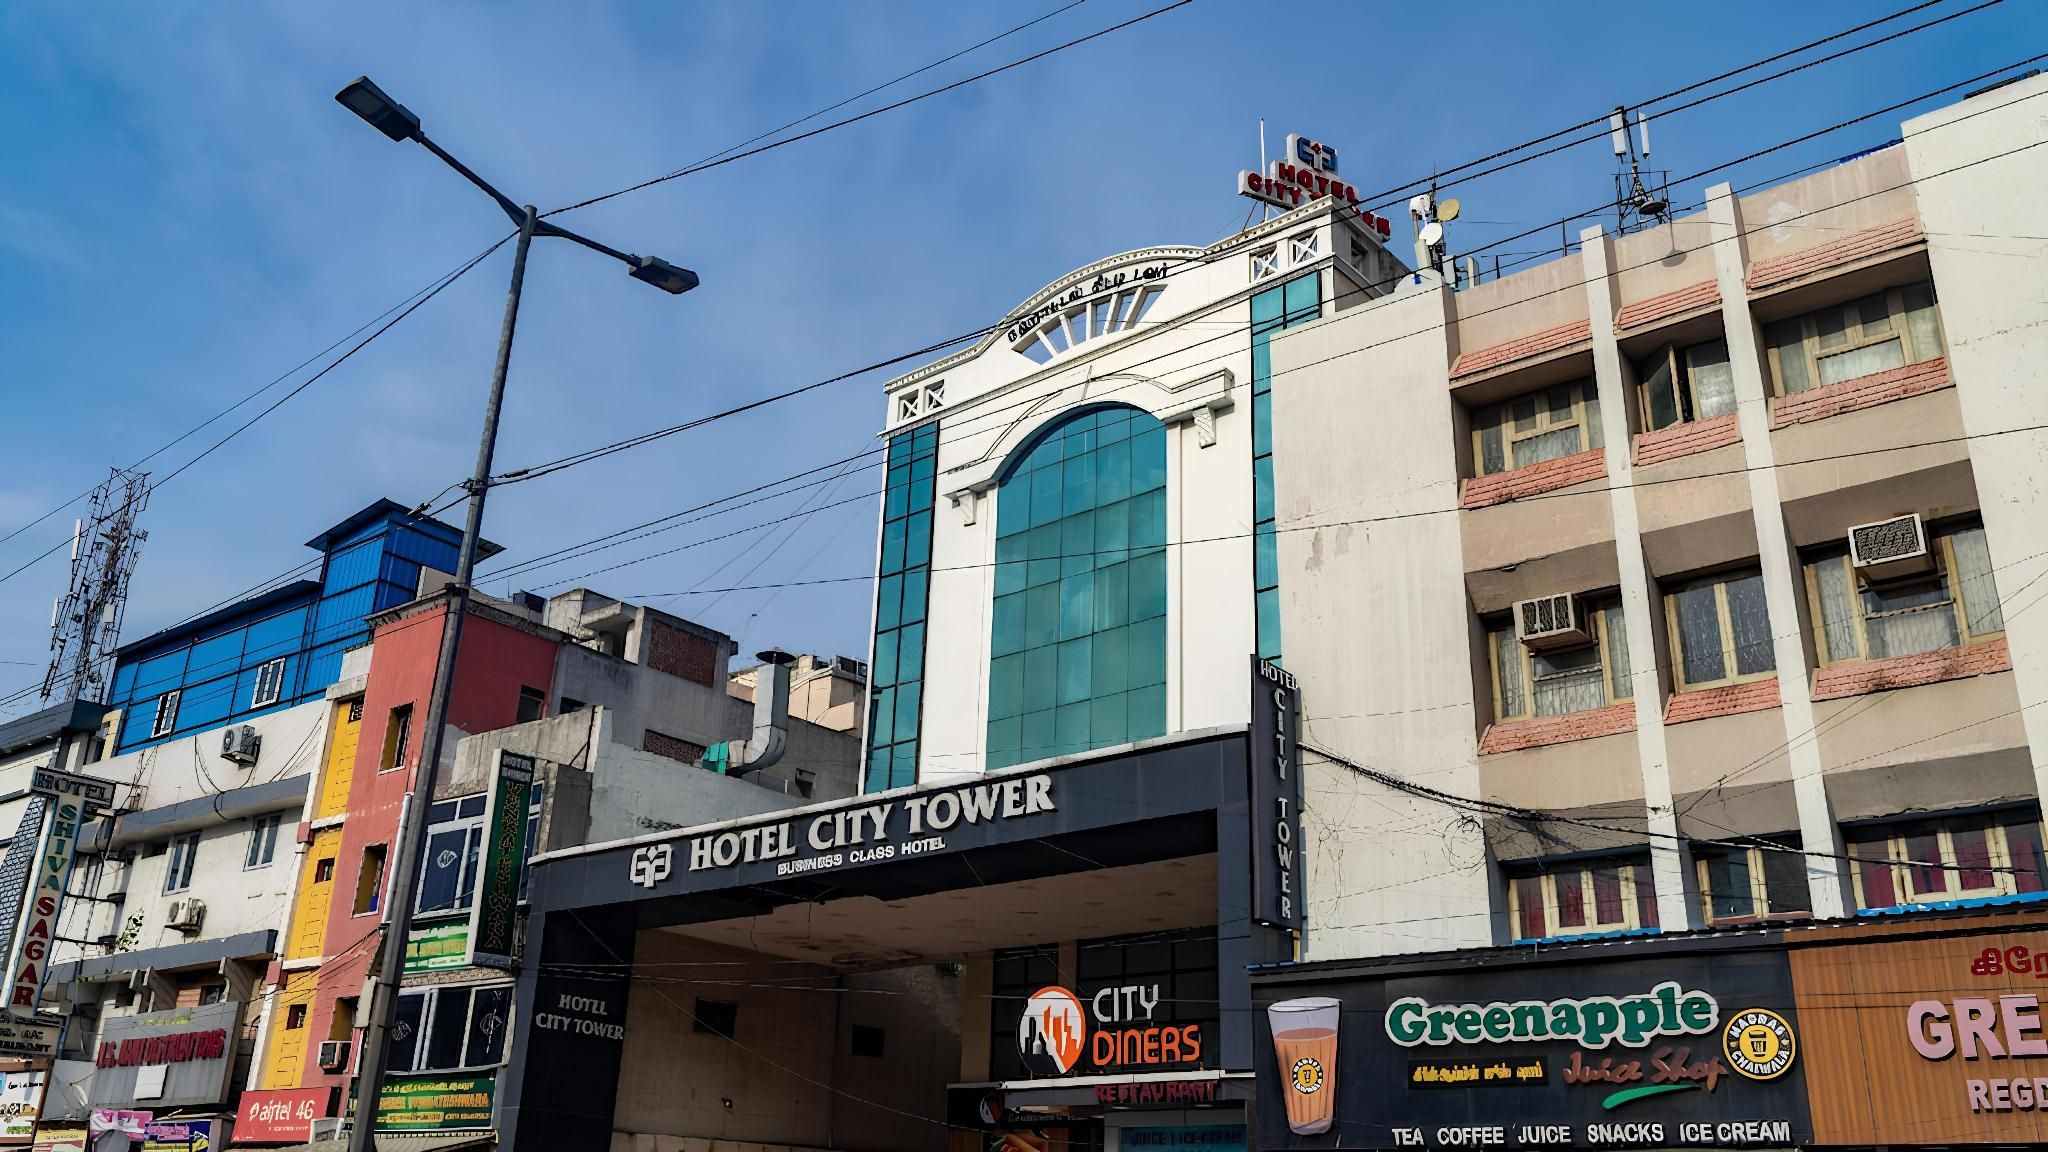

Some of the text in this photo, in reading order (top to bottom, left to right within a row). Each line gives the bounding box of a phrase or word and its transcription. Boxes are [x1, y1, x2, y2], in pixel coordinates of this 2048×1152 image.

[1247, 172, 1302, 206] CITY
[1260, 659, 1299, 690] HOTEL
[1273, 688, 1293, 919] CITY TOWER
[688, 774, 1058, 872] HOTEL CITY TOWER
[41, 803, 78, 891] SHIVA
[849, 845, 895, 864] CLASS
[901, 836, 946, 856] HOTEL
[11, 896, 56, 1007] SAGAR
[558, 994, 608, 1016] HOTEL
[1093, 984, 1160, 1023] CITY
[1385, 982, 1719, 1049] Greenapple
[535, 1012, 624, 1041] CITY TOWER
[1092, 1025, 1201, 1066] DINERS
[1562, 1050, 1644, 1084] Juice
[1650, 1046, 1729, 1093] Shop
[1094, 1080, 1218, 1104] RESTAURANT
[259, 1099, 316, 1123] airtel 4G
[1392, 1121, 1791, 1146] TEA COFFEE JUICE SNACKS ICE CREAM
